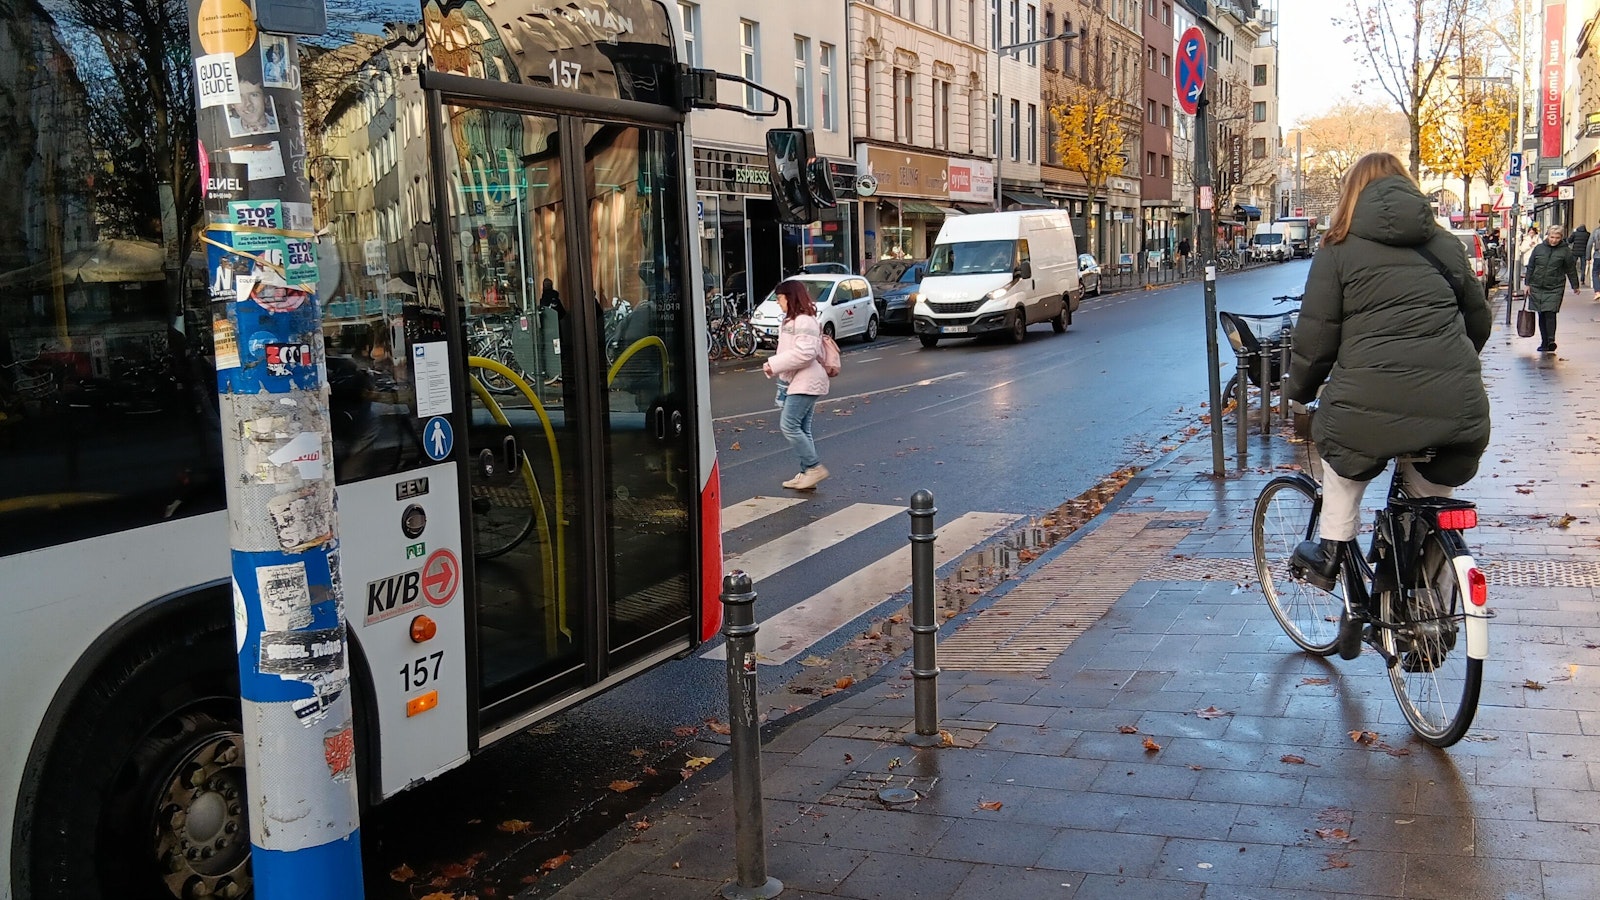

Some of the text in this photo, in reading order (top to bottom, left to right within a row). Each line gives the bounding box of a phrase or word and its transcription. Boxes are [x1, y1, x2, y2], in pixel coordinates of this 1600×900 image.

[583, 7, 635, 35] MAN
[200, 62, 232, 81] GUDE
[549, 58, 582, 90] 157
[202, 78, 234, 96] LEUDE
[1546, 39, 1560, 126] cöln comic haus
[1511, 155, 1519, 174] P
[236, 207, 275, 219] STOP
[287, 242, 312, 253] STOP
[289, 253, 314, 264] GEAS
[397, 477, 428, 498] EEV
[367, 571, 420, 616] KVB
[400, 651, 444, 691] 157
